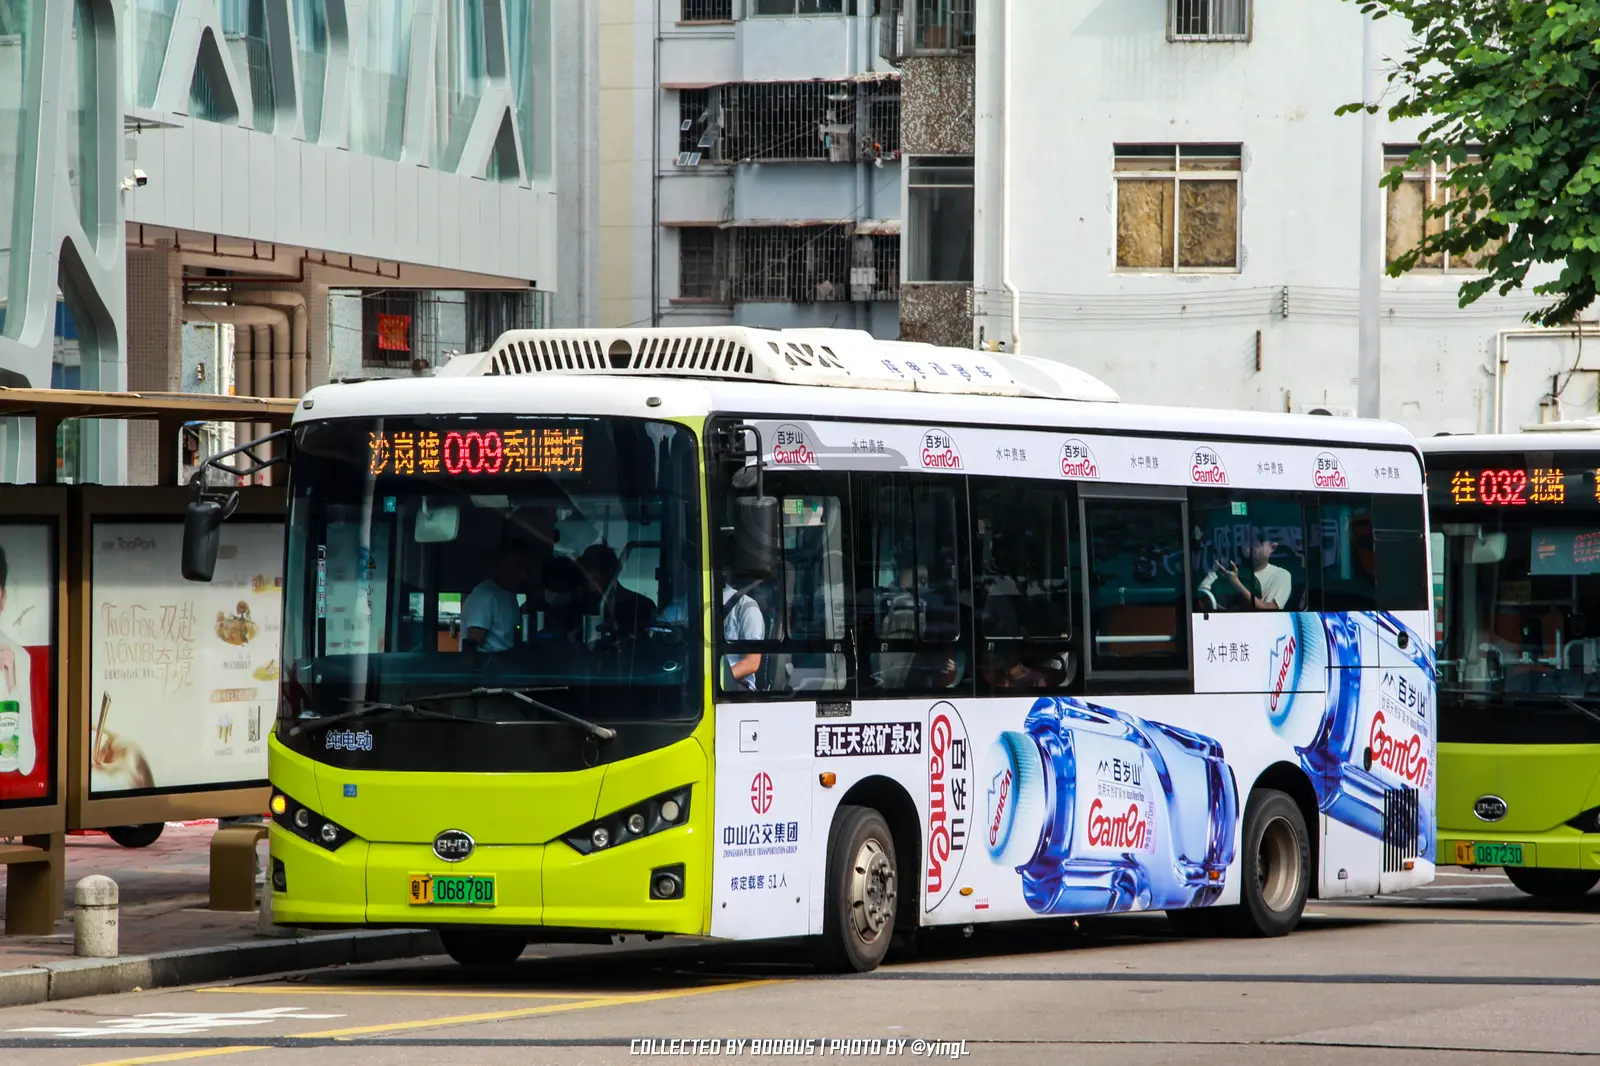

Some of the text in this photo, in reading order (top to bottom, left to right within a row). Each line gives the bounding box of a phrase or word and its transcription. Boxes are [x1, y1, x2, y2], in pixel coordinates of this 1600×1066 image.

[881, 359, 993, 379] 纯电动客车
[777, 430, 804, 445] 百岁山
[851, 438, 885, 454] 水中贵族
[925, 435, 951, 450] 百岁山
[443, 430, 503, 475] 009
[503, 428, 584, 473] 秀山牌坊
[995, 447, 1027, 463] 水中贵族
[1064, 445, 1089, 459] 百岁山
[1195, 452, 1218, 466] 百岁山
[1130, 454, 1160, 470] 水中贵族
[1256, 461, 1285, 475] 水中贵族
[1317, 457, 1339, 471] 百岁山
[1374, 466, 1401, 480] 水中贵族
[1451, 470, 1476, 505] 往
[1479, 469, 1527, 505] 032
[1207, 643, 1250, 663] 水中贵族
[1398, 674, 1426, 718] 百岁山
[325, 729, 373, 751] 纯电动
[816, 723, 921, 757] 真正天然矿泉水
[1113, 758, 1141, 786] 百岁山
[951, 738, 967, 851] 百岁山
[723, 822, 798, 846] 中山公交集团
[437, 838, 469, 853] BYD
[1478, 846, 1522, 864] 08723D
[437, 879, 494, 901] 06878D
[731, 873, 788, 891] 核定载客 51 人
